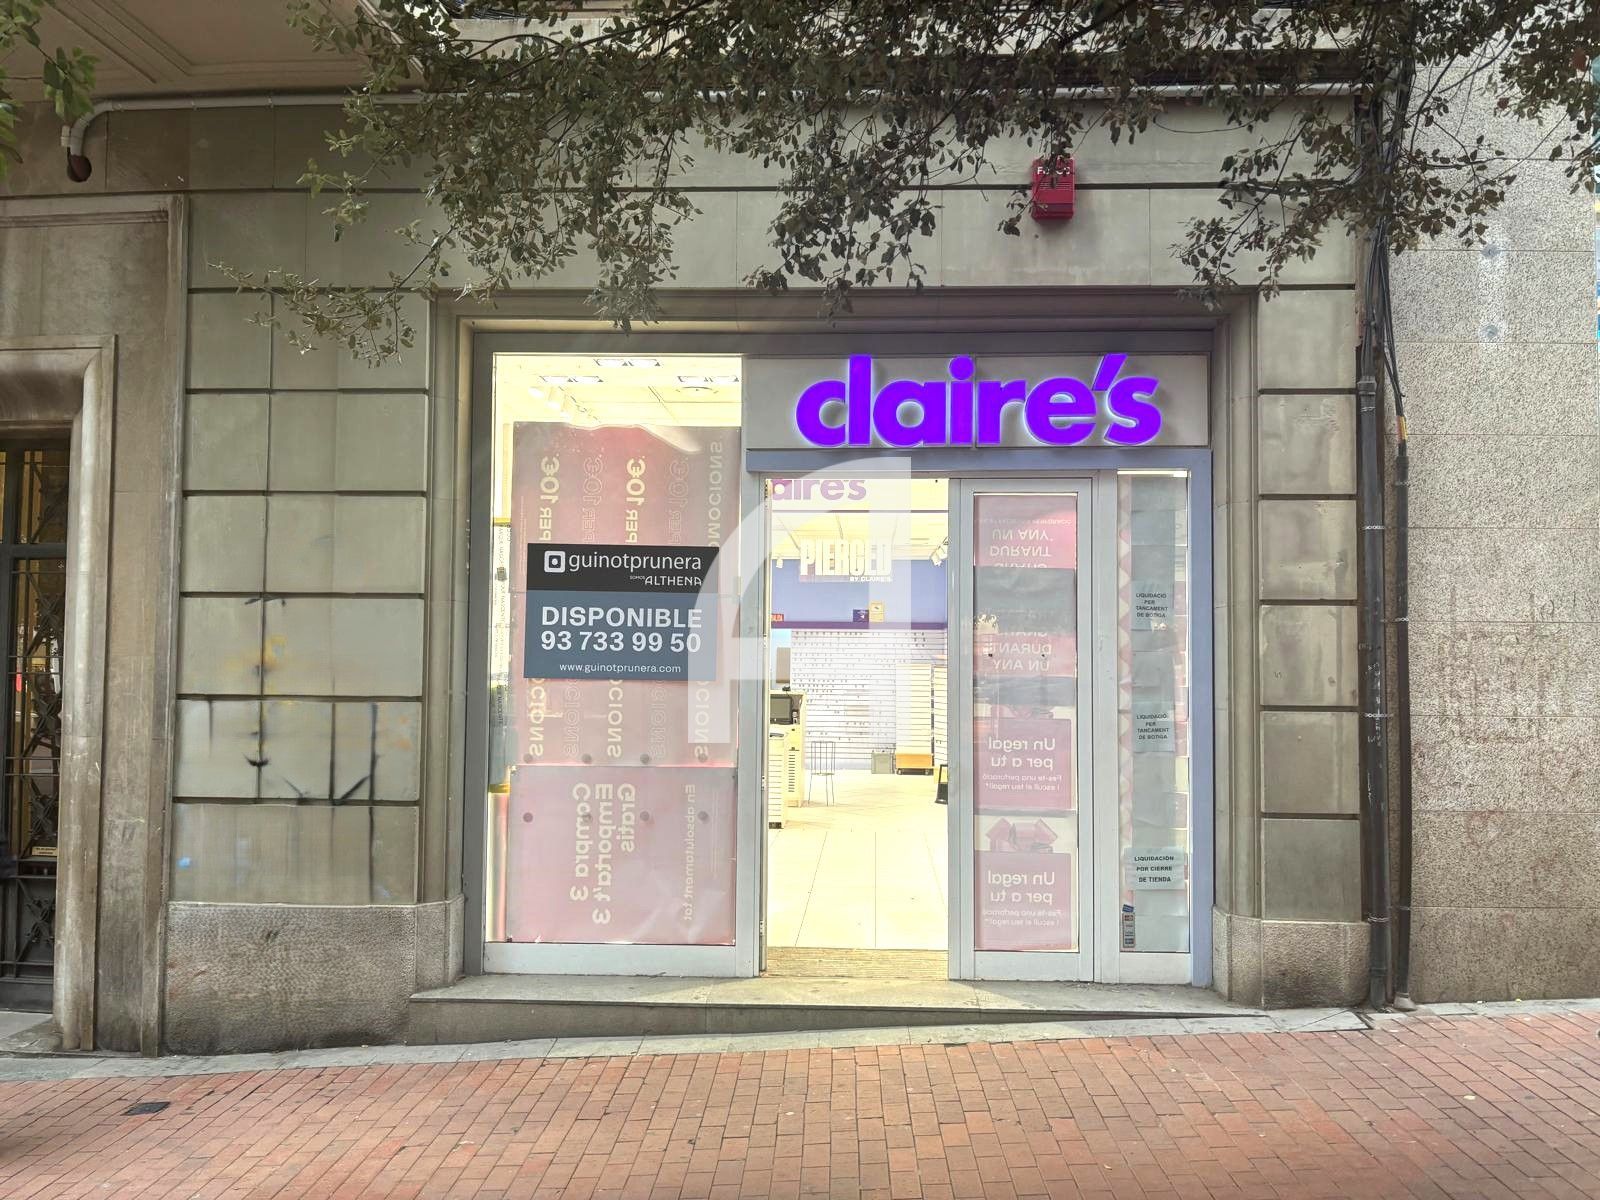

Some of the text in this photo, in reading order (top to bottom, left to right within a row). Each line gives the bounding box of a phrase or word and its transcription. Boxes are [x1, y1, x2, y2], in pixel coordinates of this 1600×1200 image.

[796, 353, 1163, 447] claire's
[569, 552, 702, 572] guinotprunera
[645, 575, 702, 586] ALTHENA
[541, 606, 703, 629] DISPONIBLE
[541, 630, 701, 653] 93 733 99 50
[559, 662, 681, 674] www.guinotprunera.com
